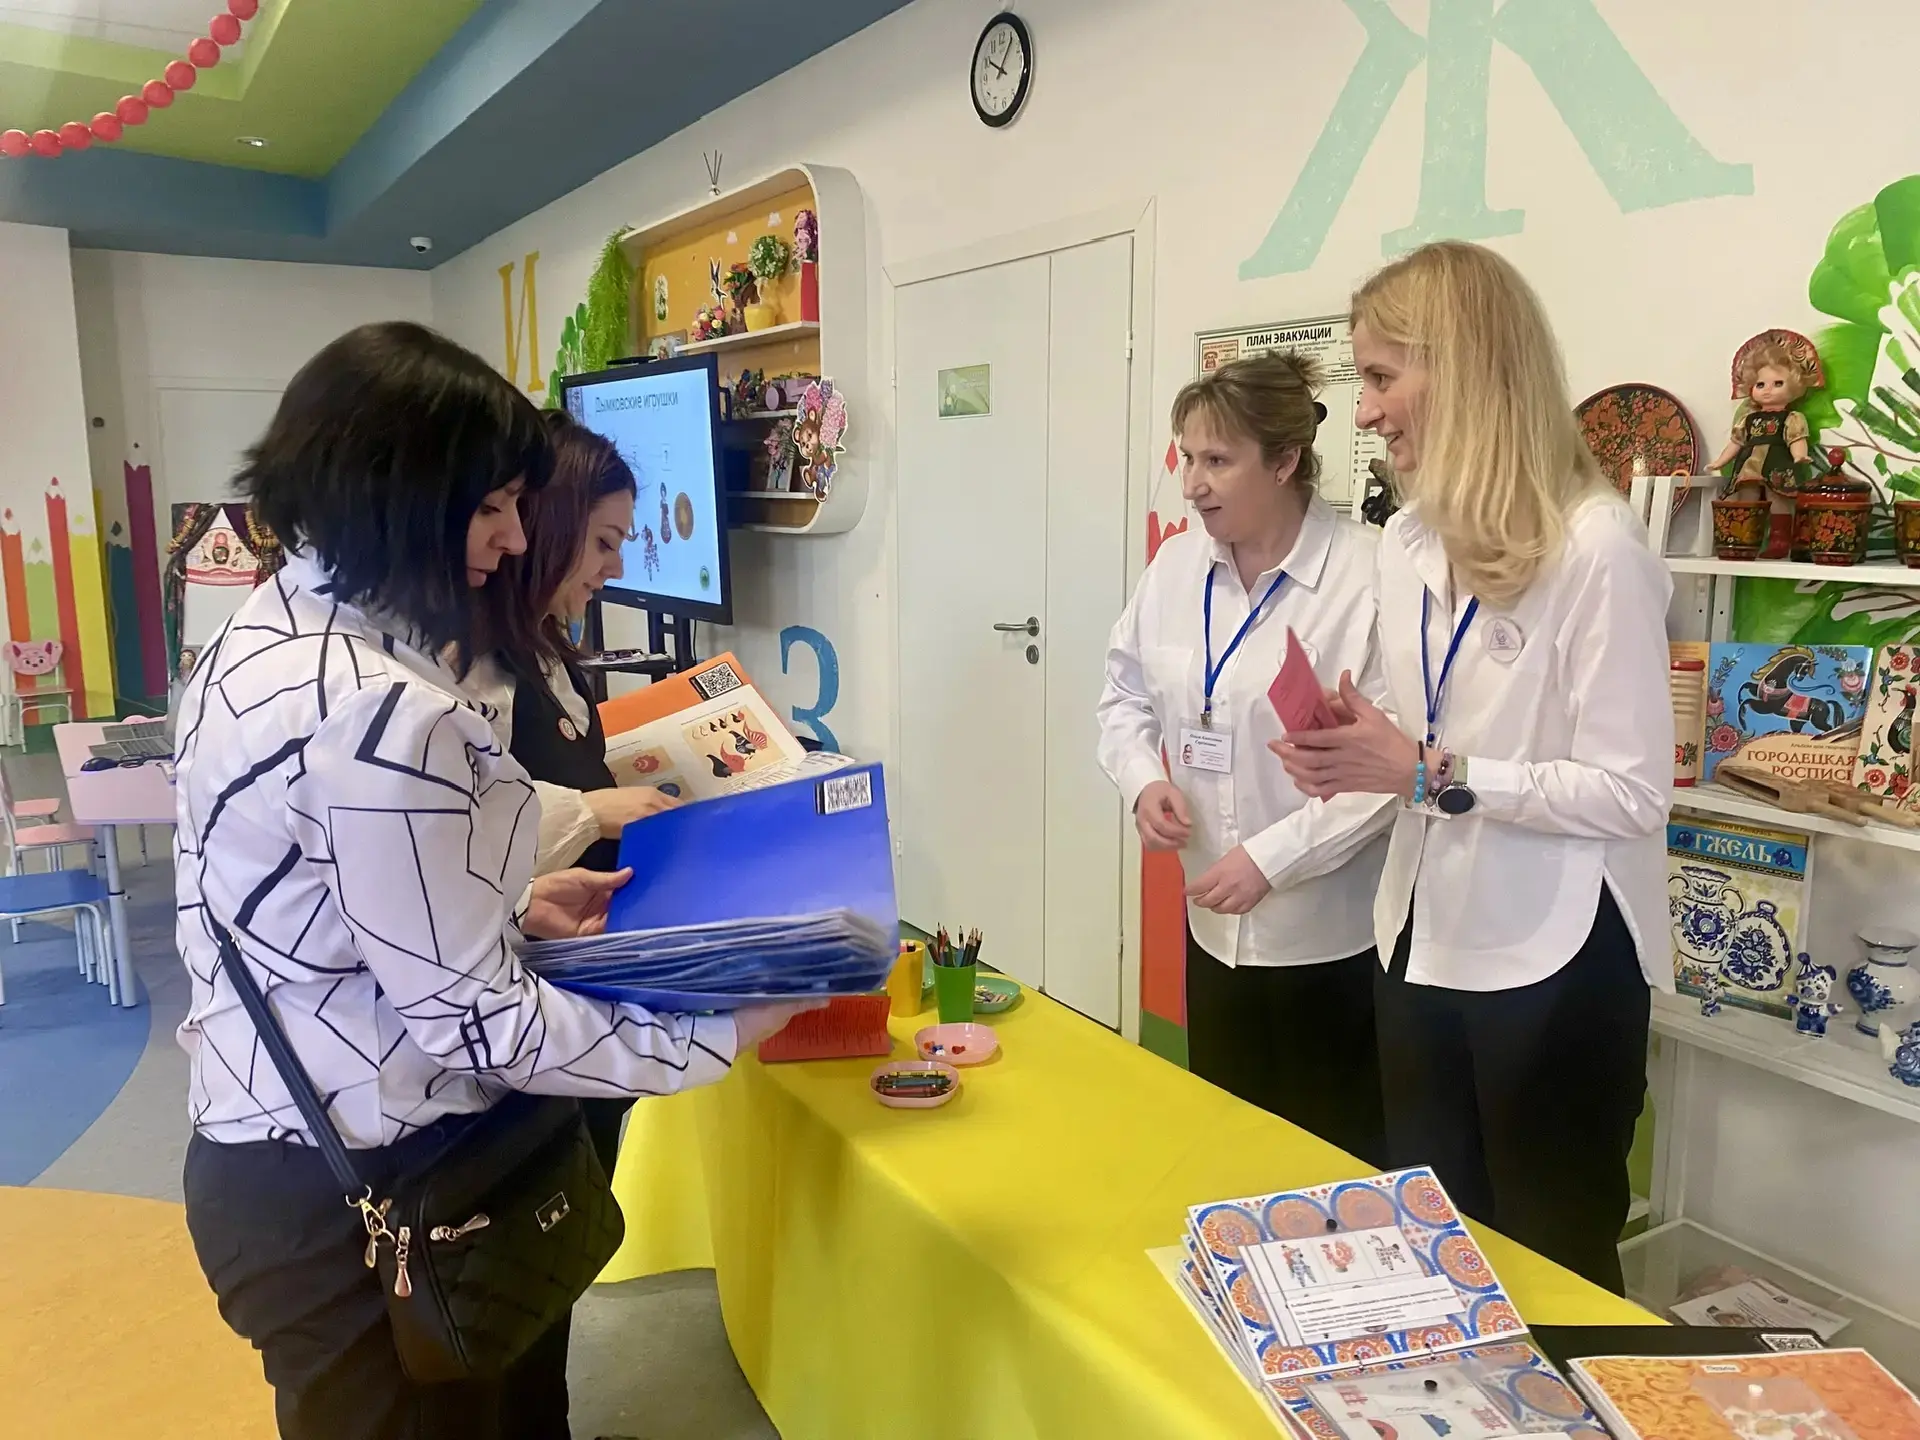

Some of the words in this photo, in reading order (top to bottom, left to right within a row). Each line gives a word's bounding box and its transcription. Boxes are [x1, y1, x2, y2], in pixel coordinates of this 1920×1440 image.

[990, 40, 996, 54] 11
[999, 31, 1006, 46] 12
[497, 250, 545, 393] И
[1246, 334, 1272, 347] ПЛАН
[1273, 327, 1332, 343] ЭВАКУАЦИИ
[595, 395, 642, 413] Дымковские
[643, 391, 679, 411] игрушки
[1747, 750, 1857, 767] ГОРОДЕЦКАЯ
[1693, 832, 1772, 863] ГЖЕЛЬ
